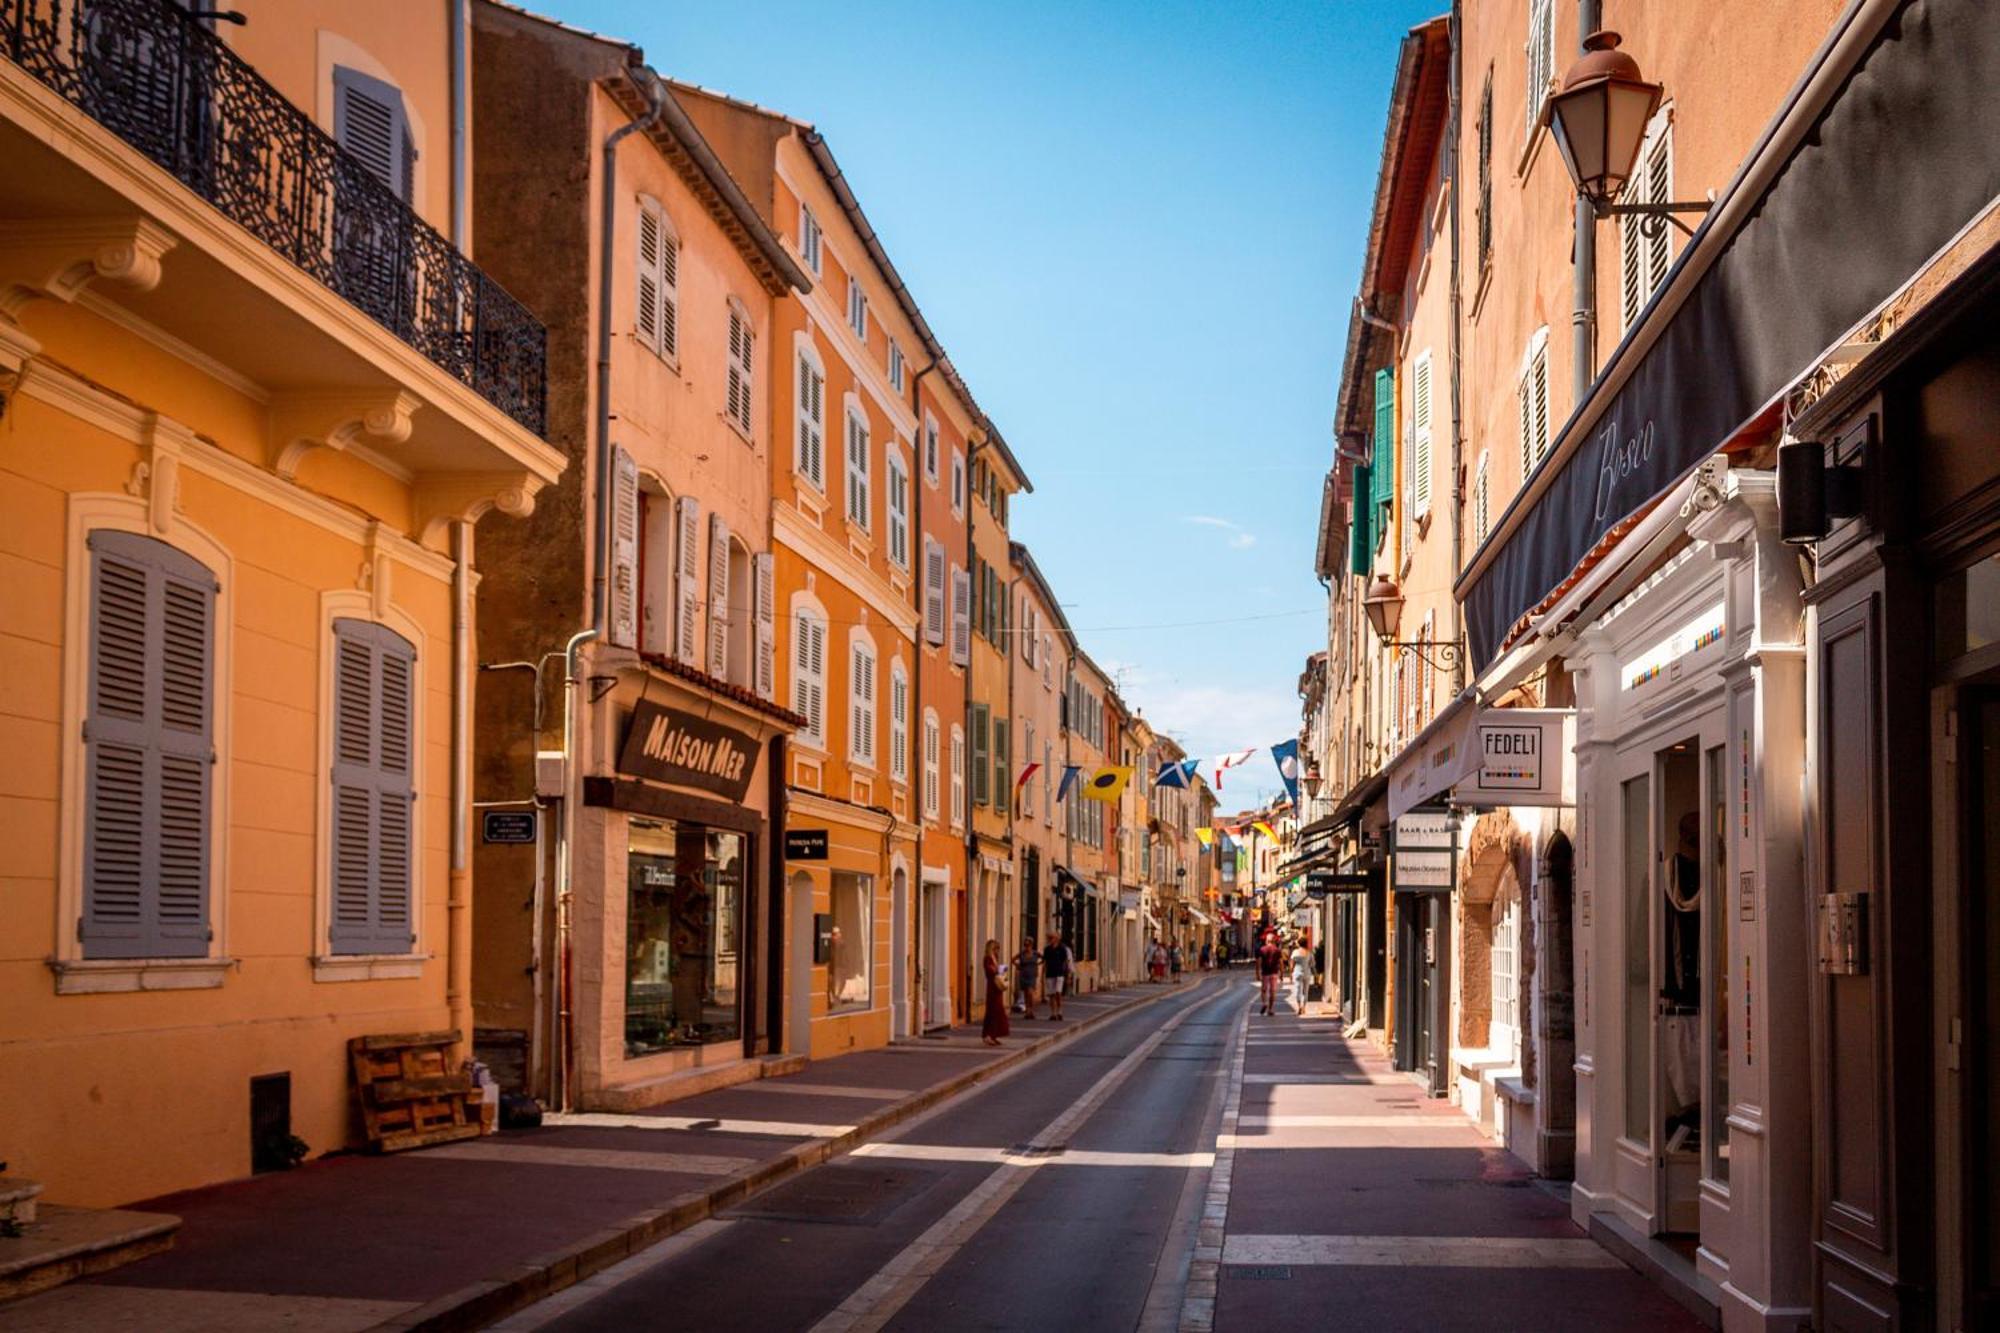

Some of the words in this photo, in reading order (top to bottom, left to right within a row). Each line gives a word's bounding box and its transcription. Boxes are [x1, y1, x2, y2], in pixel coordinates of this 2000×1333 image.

[1596, 420, 1654, 521] Bosco
[709, 737, 747, 782] MER
[1485, 733, 1535, 755] FEDELI
